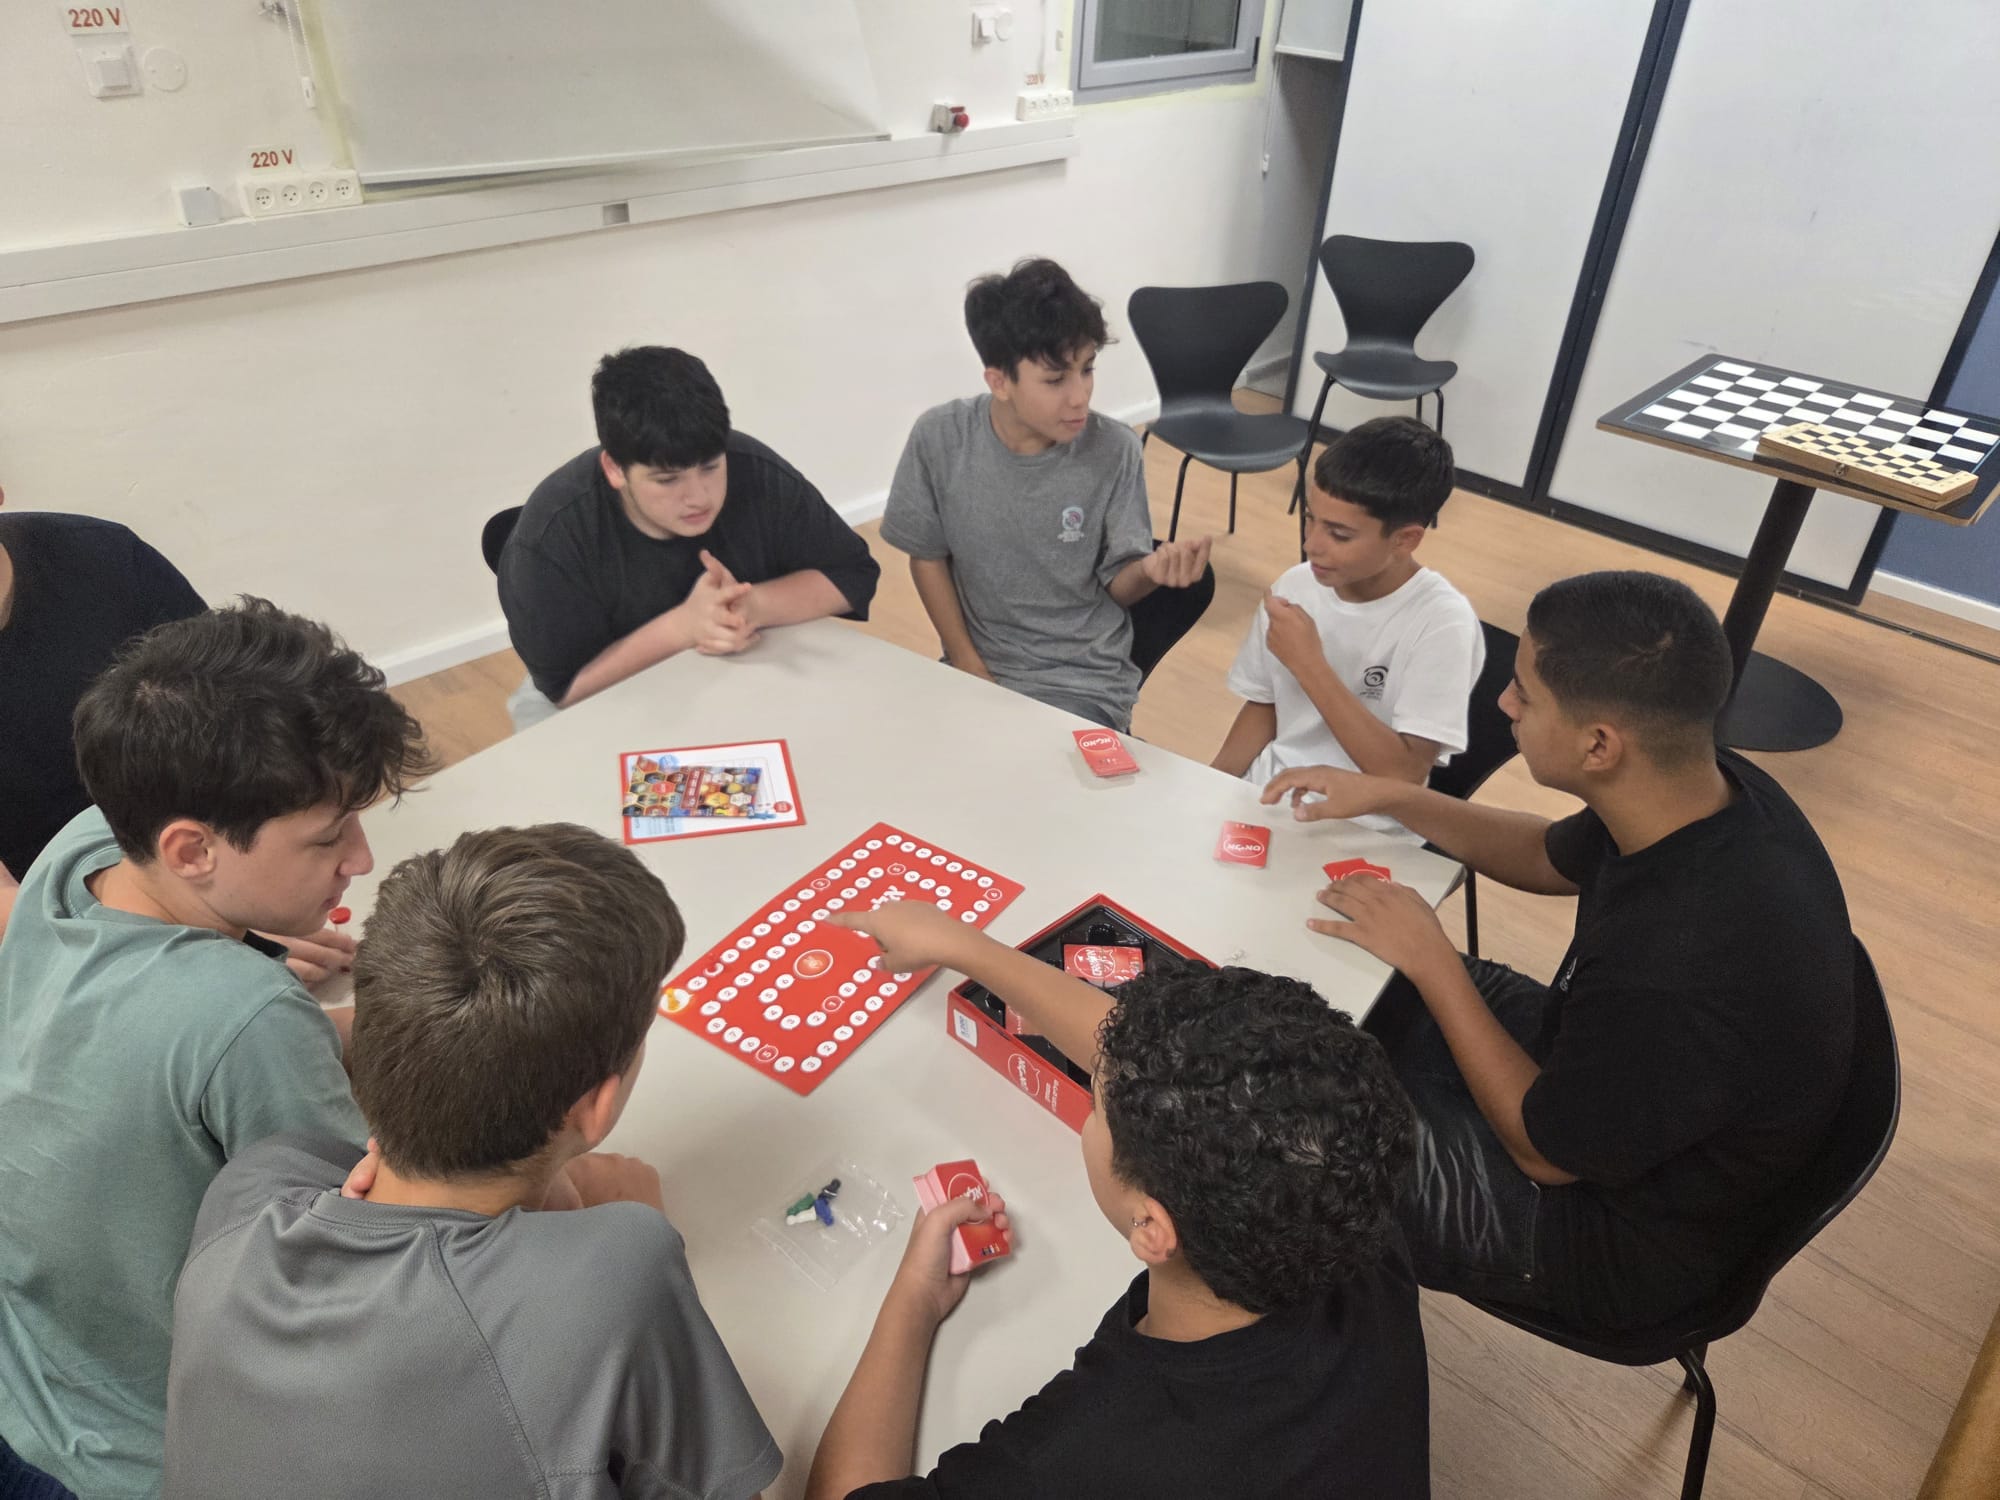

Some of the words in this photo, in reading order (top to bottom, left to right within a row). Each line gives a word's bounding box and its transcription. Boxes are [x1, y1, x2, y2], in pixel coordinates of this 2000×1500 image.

[69, 8, 104, 27] 220
[106, 8, 121, 26] V
[251, 151, 279, 168] 220
[282, 149, 293, 165] V
